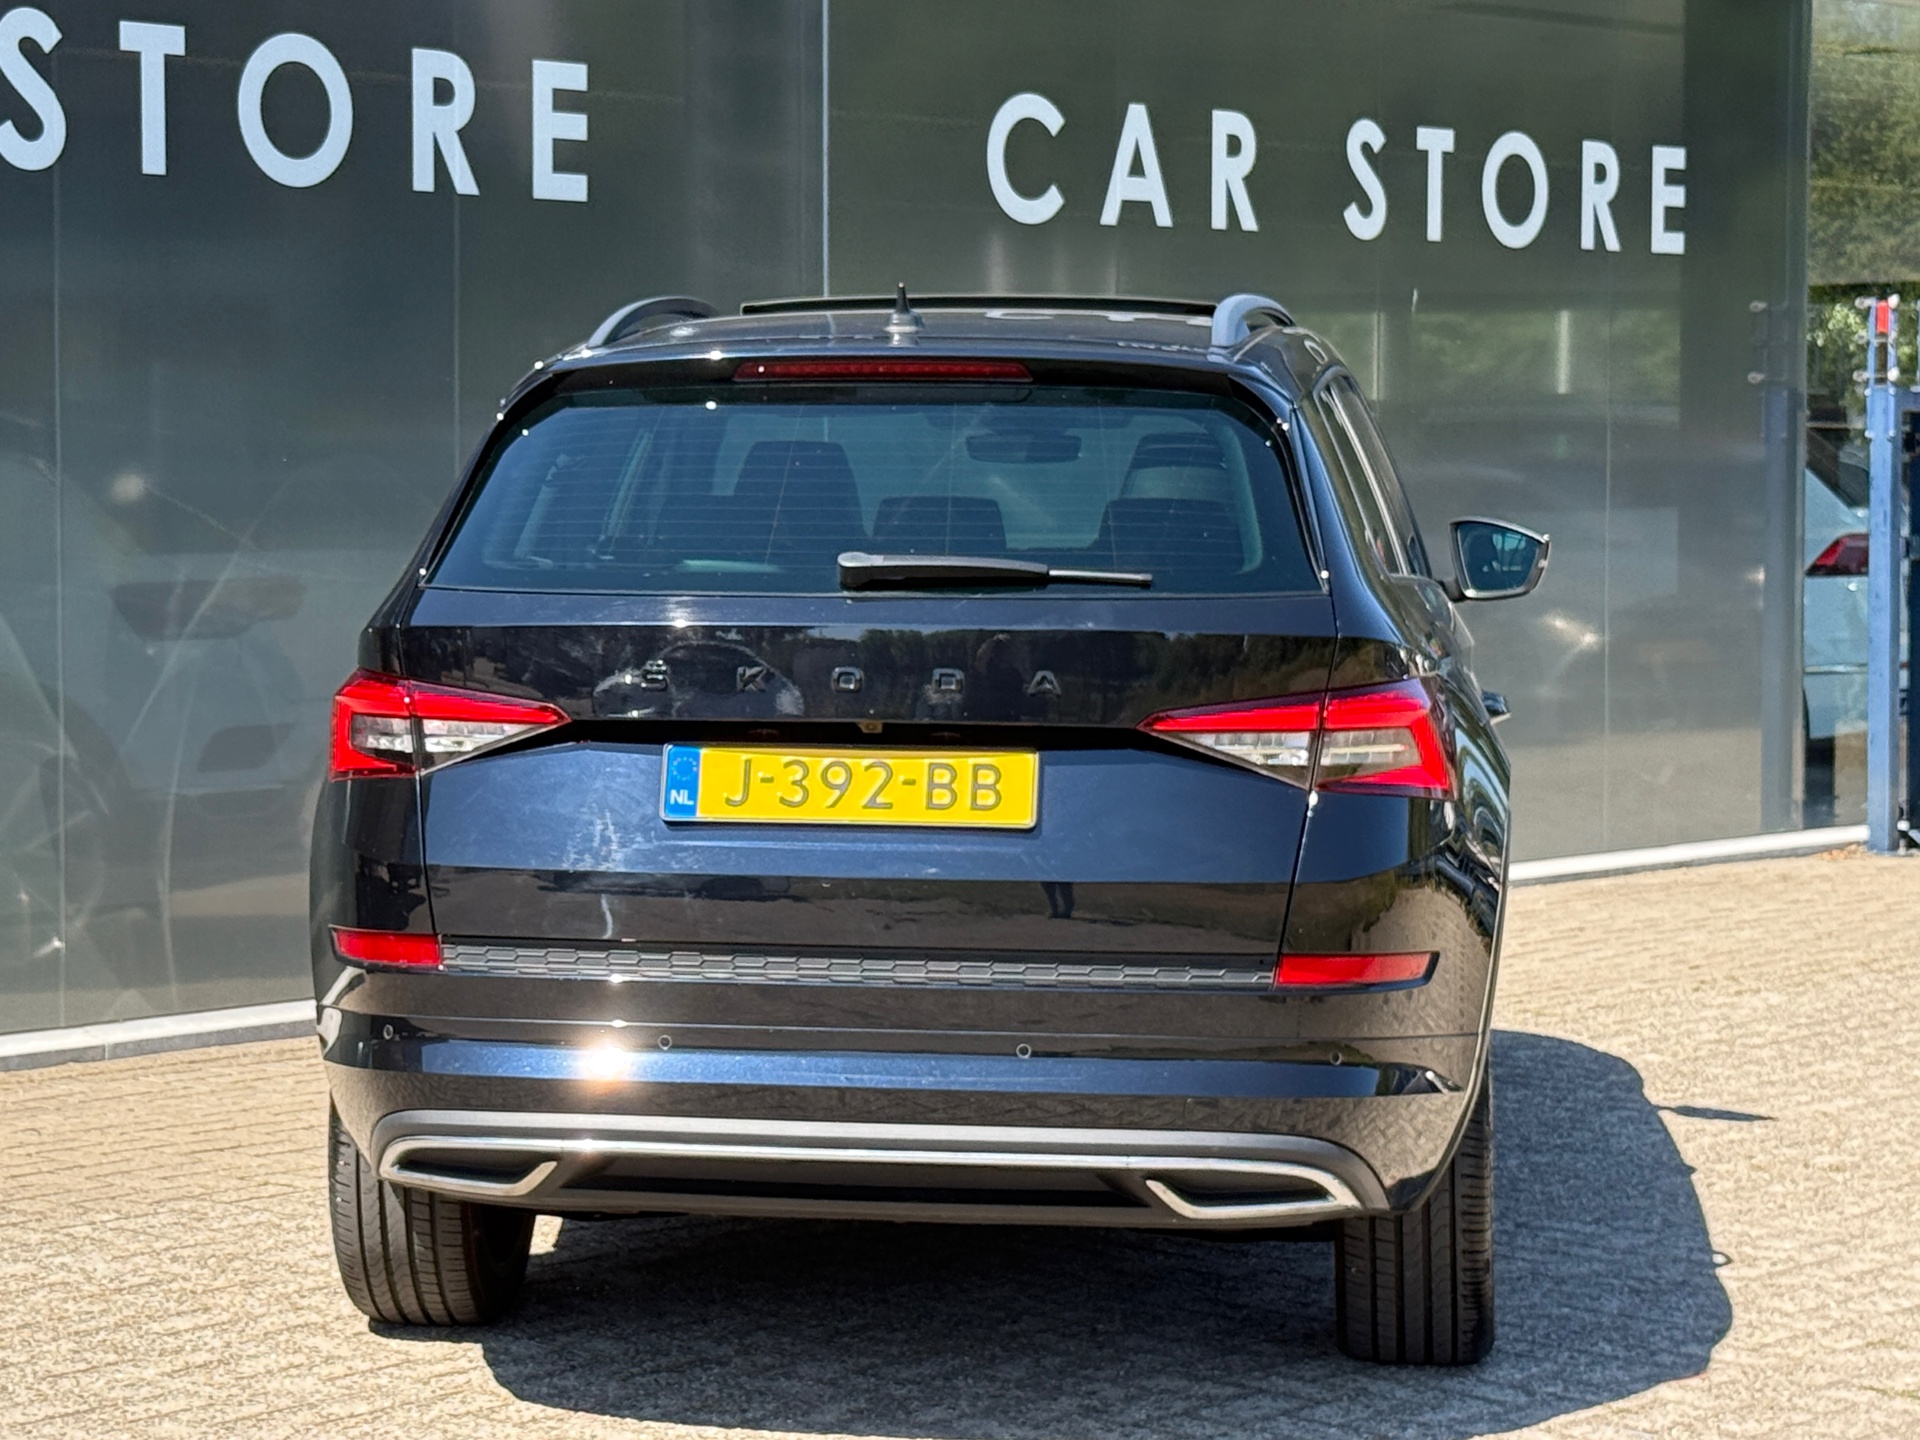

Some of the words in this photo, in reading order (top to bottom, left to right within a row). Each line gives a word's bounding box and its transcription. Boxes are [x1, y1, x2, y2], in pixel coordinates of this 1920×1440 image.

[0, 7, 589, 203] STORE
[986, 92, 1260, 232] CAR
[1343, 117, 1688, 256] STORE
[669, 789, 694, 806] NL
[724, 758, 1002, 811] J-392-BB
